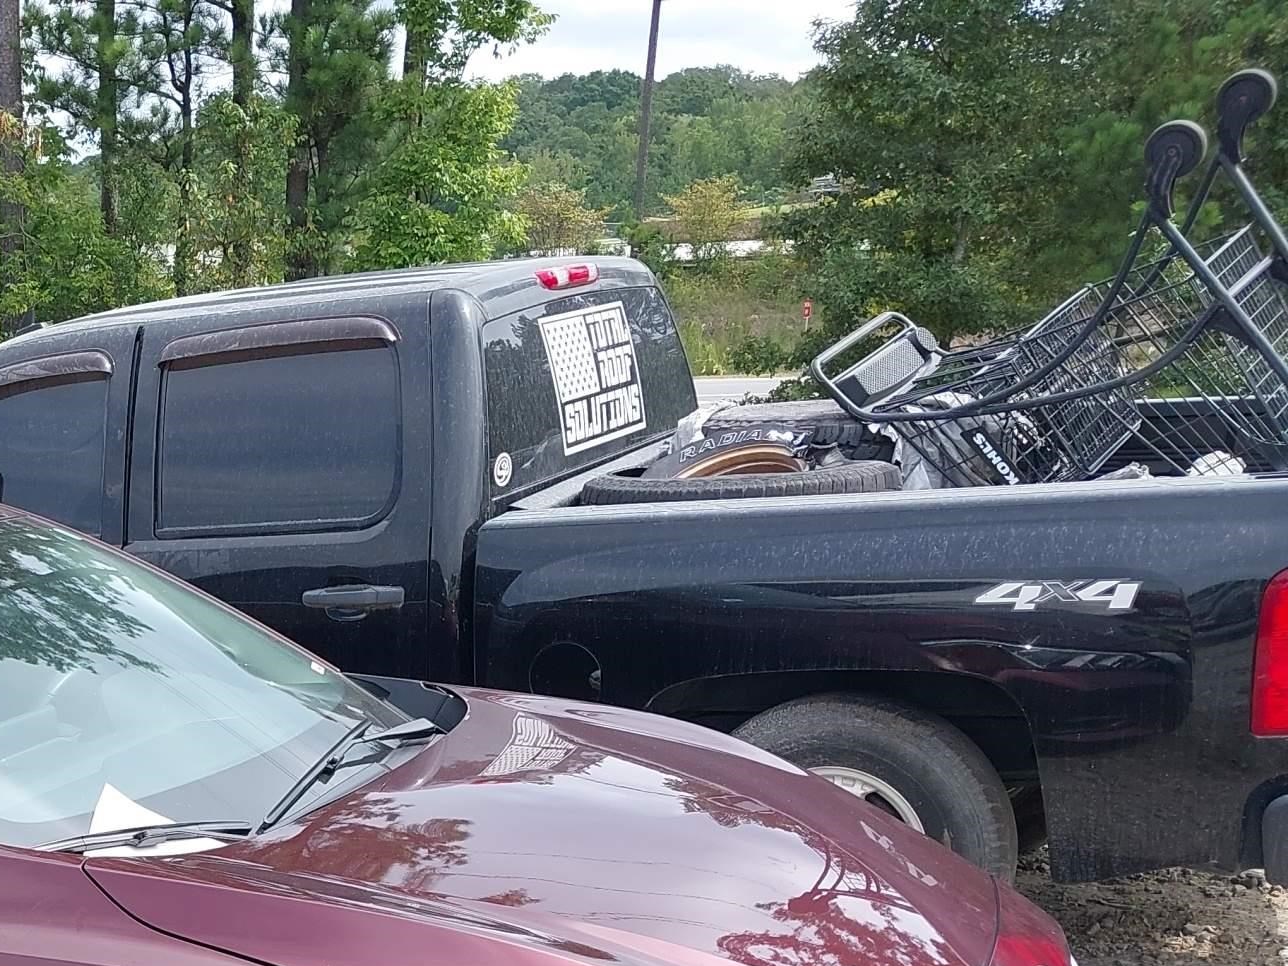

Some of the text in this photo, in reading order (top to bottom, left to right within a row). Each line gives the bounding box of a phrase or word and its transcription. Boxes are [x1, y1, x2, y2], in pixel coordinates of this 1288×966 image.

[585, 307, 629, 351] TOTAL
[597, 344, 633, 390] ROOF
[564, 383, 642, 444] SOLUTIONS
